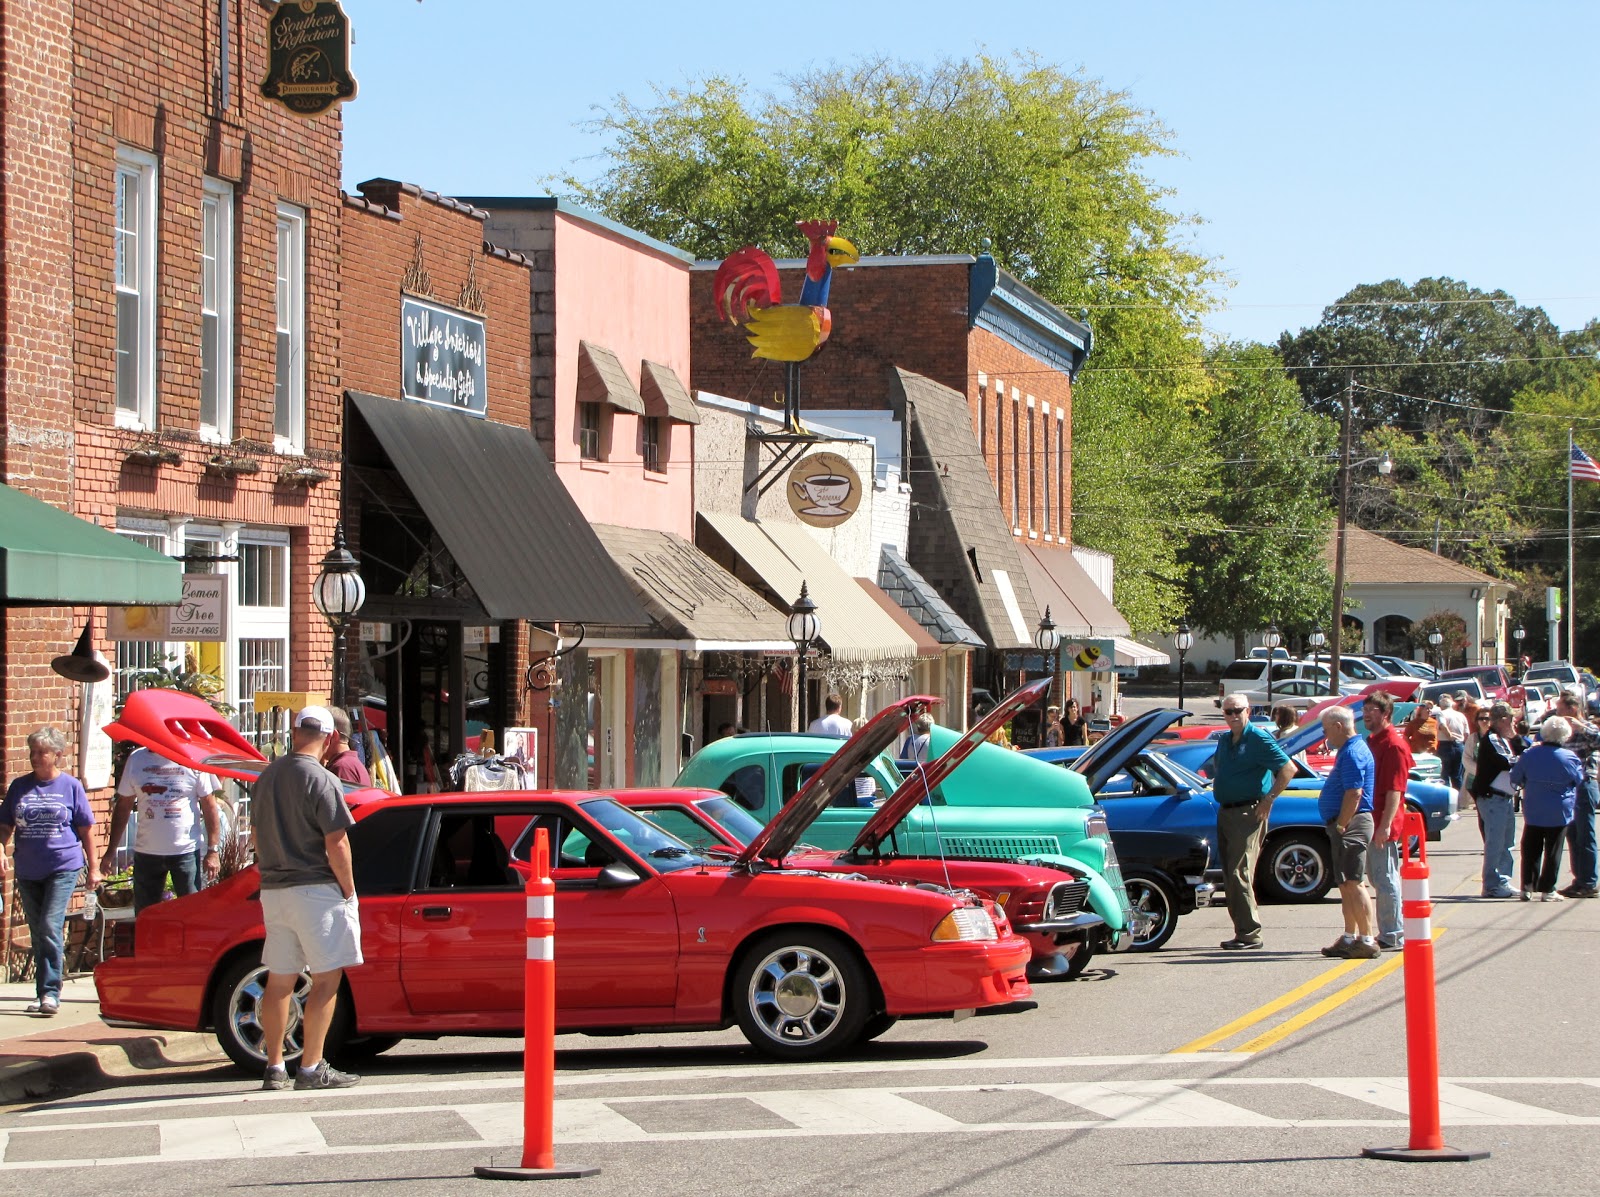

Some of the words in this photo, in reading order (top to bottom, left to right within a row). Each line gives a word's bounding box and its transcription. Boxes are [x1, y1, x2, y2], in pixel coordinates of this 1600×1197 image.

[274, 13, 336, 37] Southern
[273, 27, 340, 50] Reflections
[406, 310, 444, 362] Village
[444, 318, 482, 367] Interiors
[423, 362, 458, 403] Specialty
[458, 369, 475, 406] Gifts
[182, 580, 219, 600] Lemon
[176, 602, 215, 622] Tree
